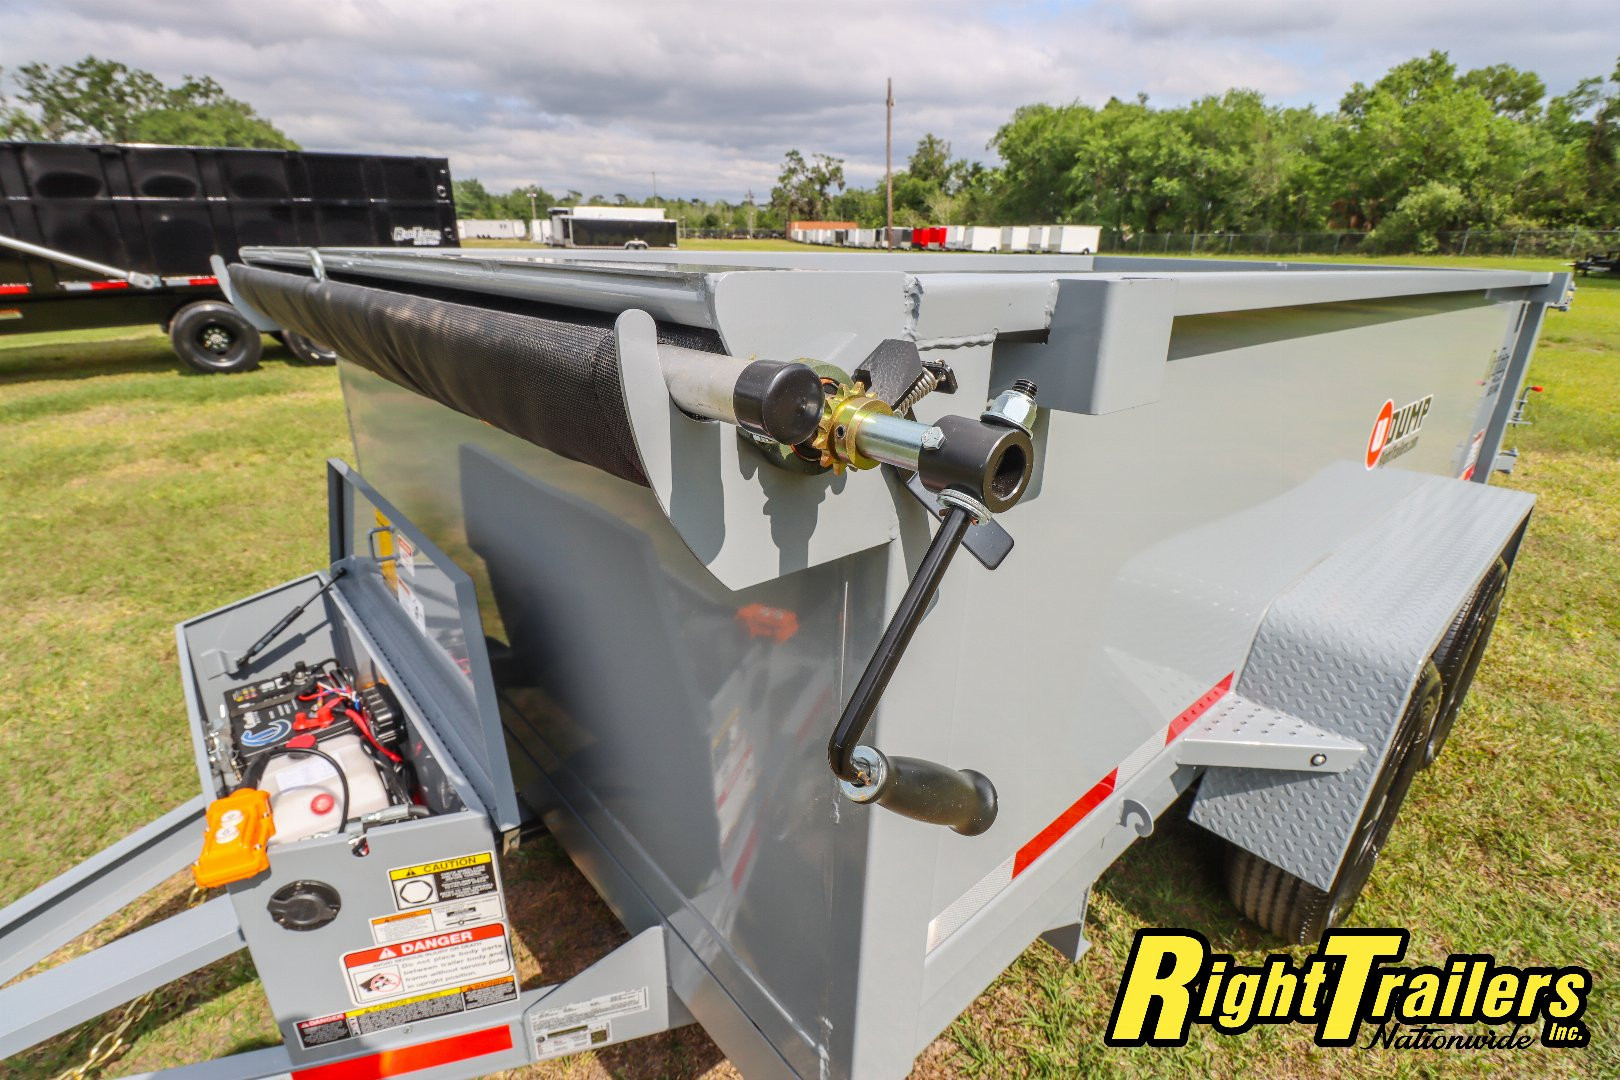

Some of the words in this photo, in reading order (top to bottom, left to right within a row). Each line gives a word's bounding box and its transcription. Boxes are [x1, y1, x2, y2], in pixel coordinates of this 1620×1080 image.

[423, 857, 477, 873] CAUTION
[401, 931, 473, 954] DANGER
[434, 953, 454, 962] place
[459, 948, 477, 956] body
[482, 943, 501, 951] parts
[403, 964, 437, 975] between
[440, 958, 463, 967] trailer
[467, 954, 485, 962] body
[405, 973, 427, 981] frame
[430, 967, 457, 976] without
[460, 960, 486, 970] service
[488, 957, 504, 965] pole
[416, 977, 442, 987] upright
[308, 1013, 344, 1026] DANGER
